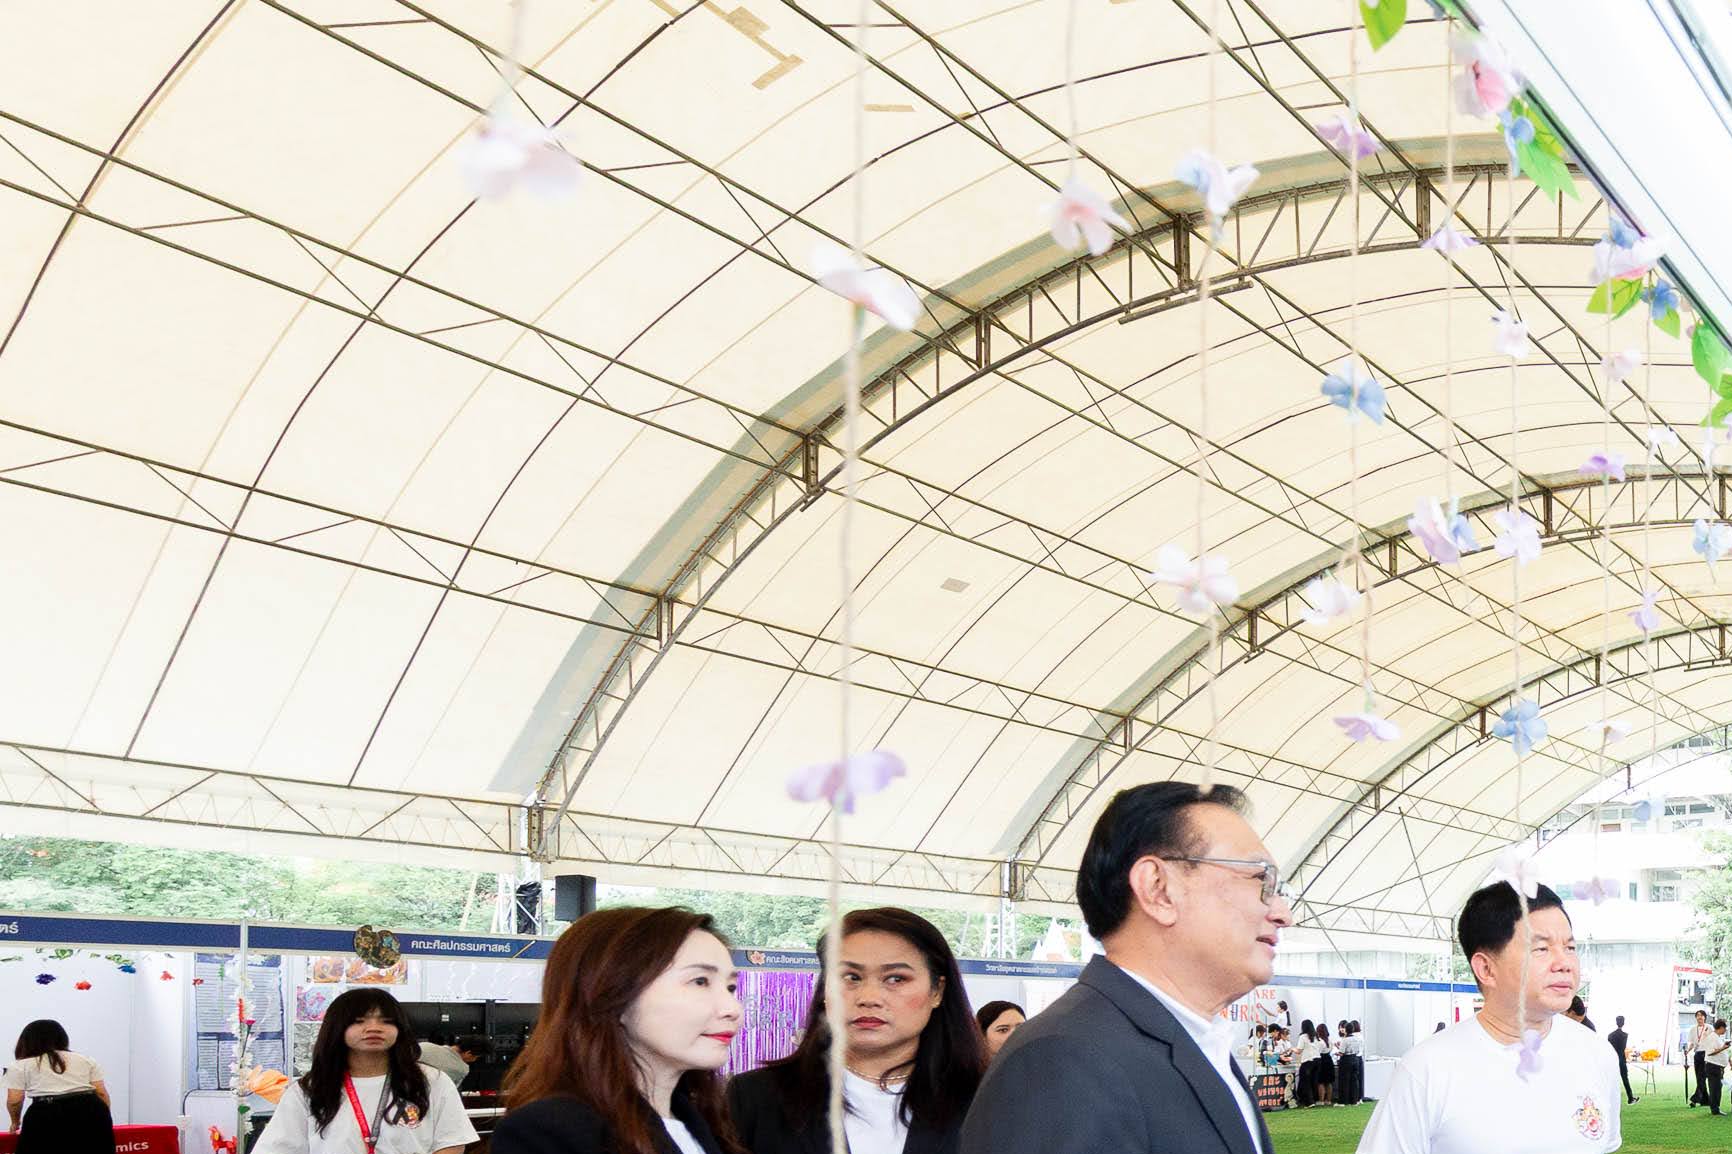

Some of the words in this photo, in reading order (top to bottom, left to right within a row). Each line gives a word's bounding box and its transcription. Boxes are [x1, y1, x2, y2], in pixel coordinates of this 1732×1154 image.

[411, 939, 511, 953] คณะศิลปกรรมศาสตร์
